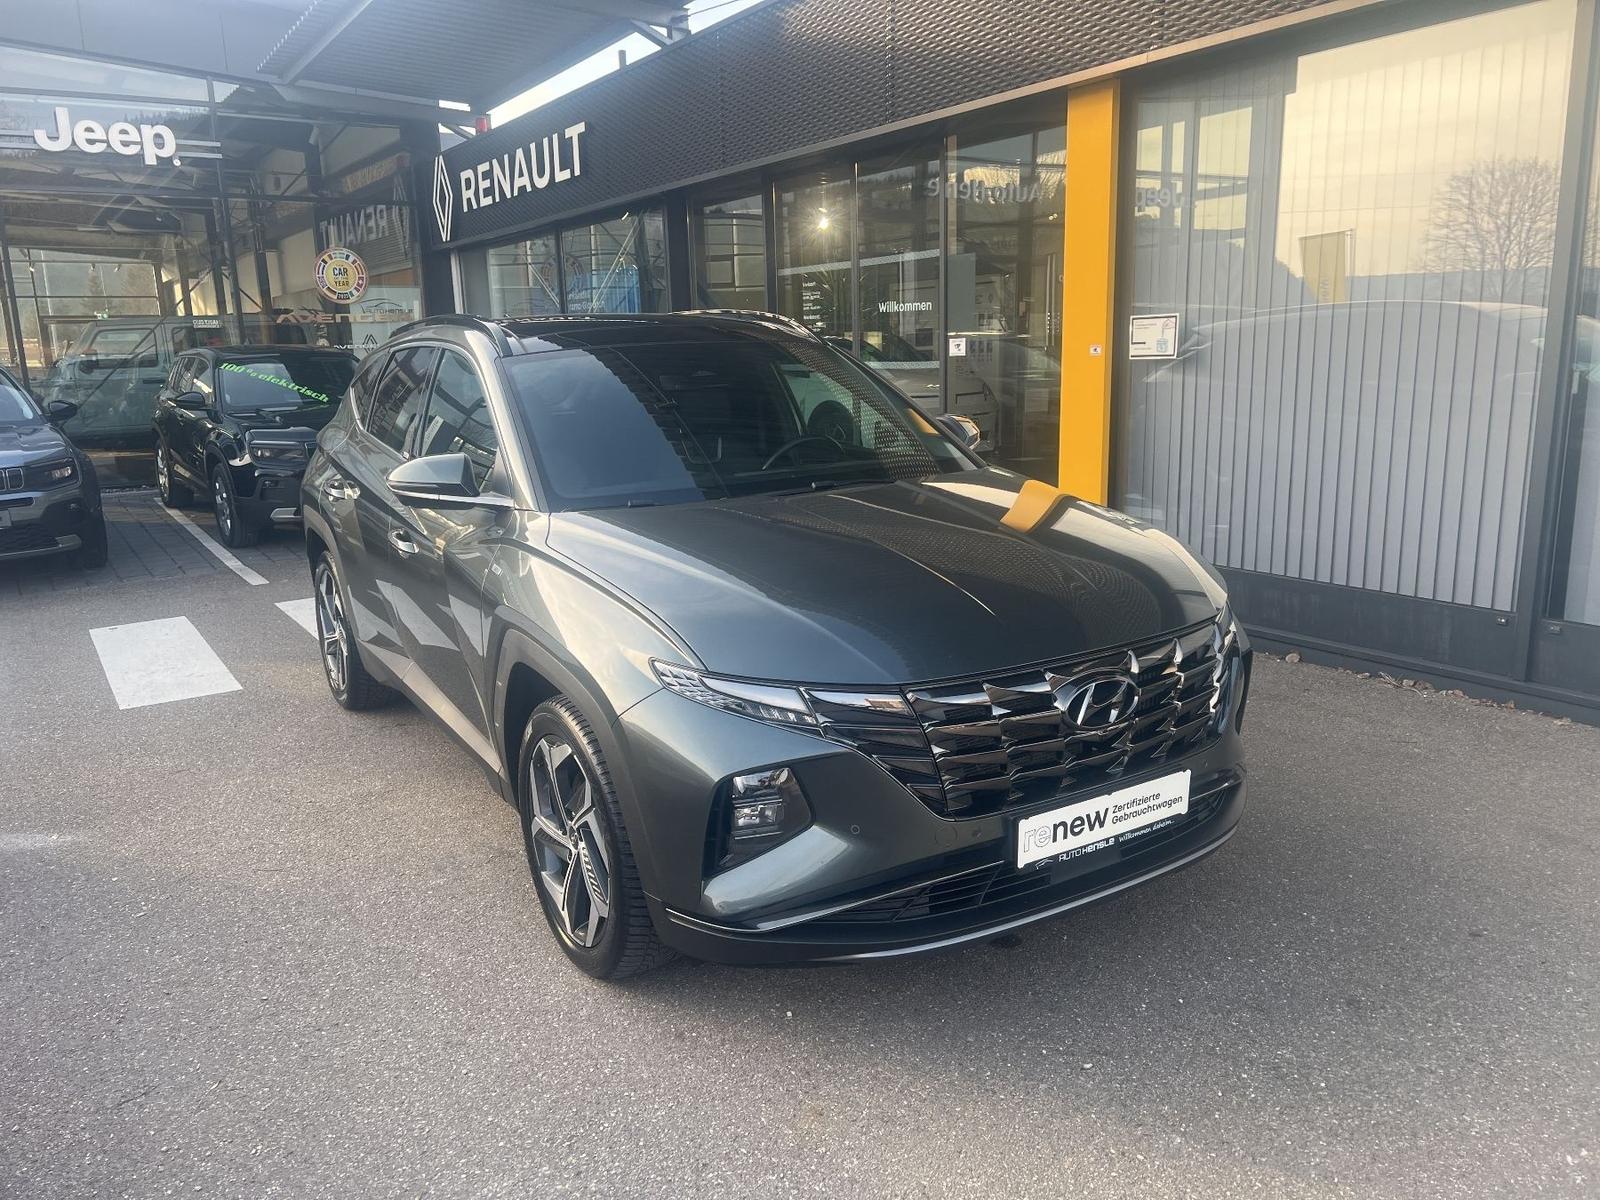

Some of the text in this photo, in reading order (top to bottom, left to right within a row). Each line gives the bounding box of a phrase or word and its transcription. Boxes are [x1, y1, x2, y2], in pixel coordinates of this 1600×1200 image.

[33, 107, 177, 166] Jeep
[459, 121, 587, 213] RENAULT
[332, 267, 349, 277] CAR
[878, 301, 933, 313] Willkommen
[219, 362, 246, 373] 100
[257, 374, 330, 402] elektrisch
[1111, 796, 1183, 825] Gebrauchtwagen
[1112, 792, 1161, 814] Zertifizierte
[1023, 807, 1109, 853] renew
